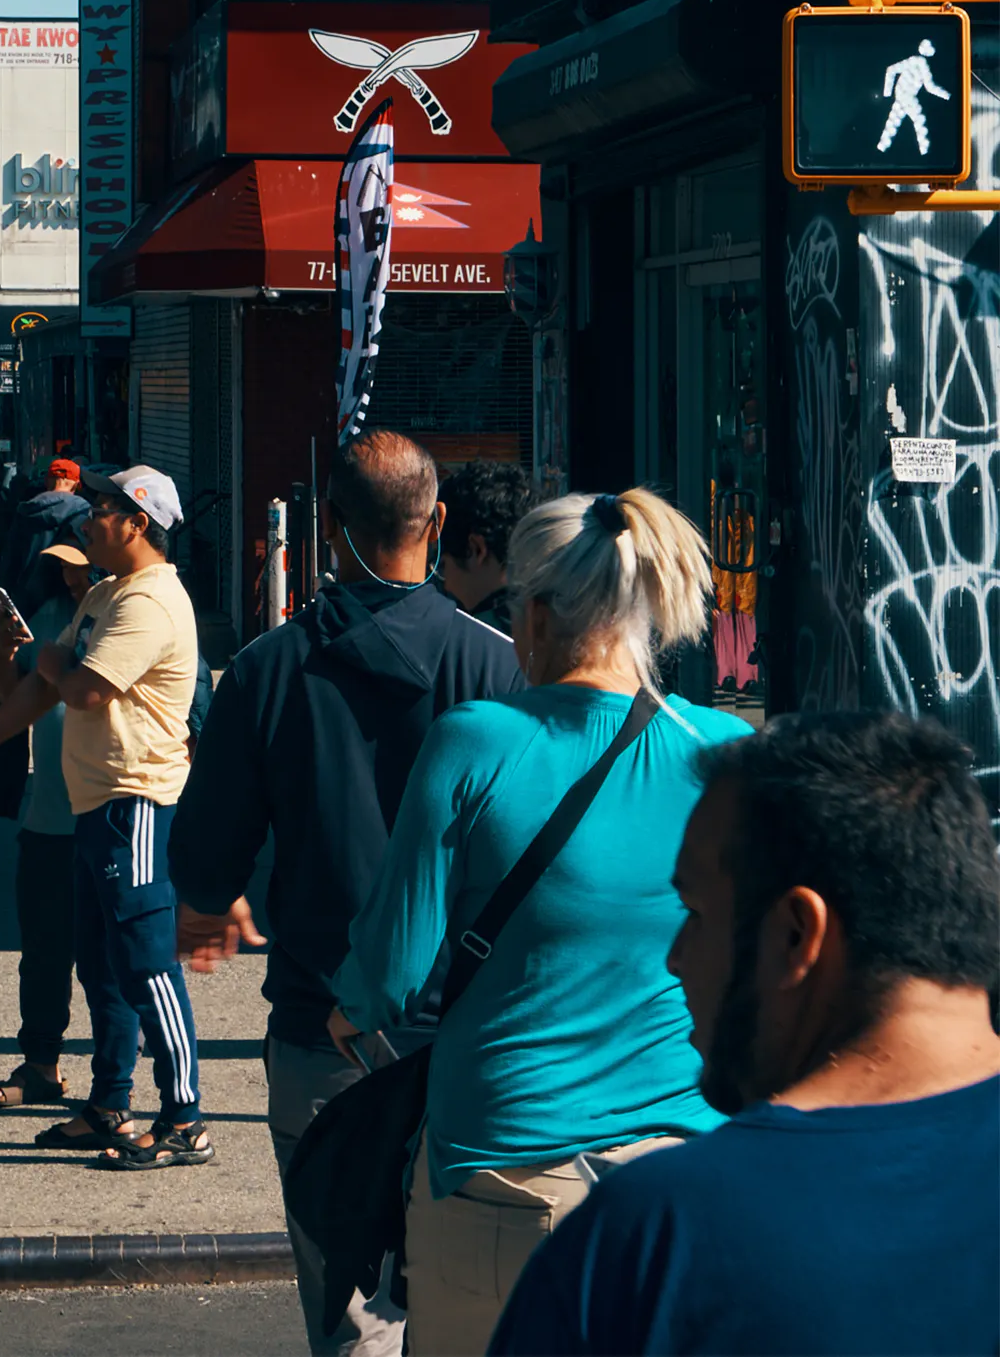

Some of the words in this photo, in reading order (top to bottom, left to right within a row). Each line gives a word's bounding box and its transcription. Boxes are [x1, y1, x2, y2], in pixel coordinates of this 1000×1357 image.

[36, 27, 79, 47] KWO
[53, 52, 79, 64] 718-
[13, 199, 79, 220] FITN
[388, 263, 449, 283] SEVELT
[454, 264, 491, 283] AVE.
